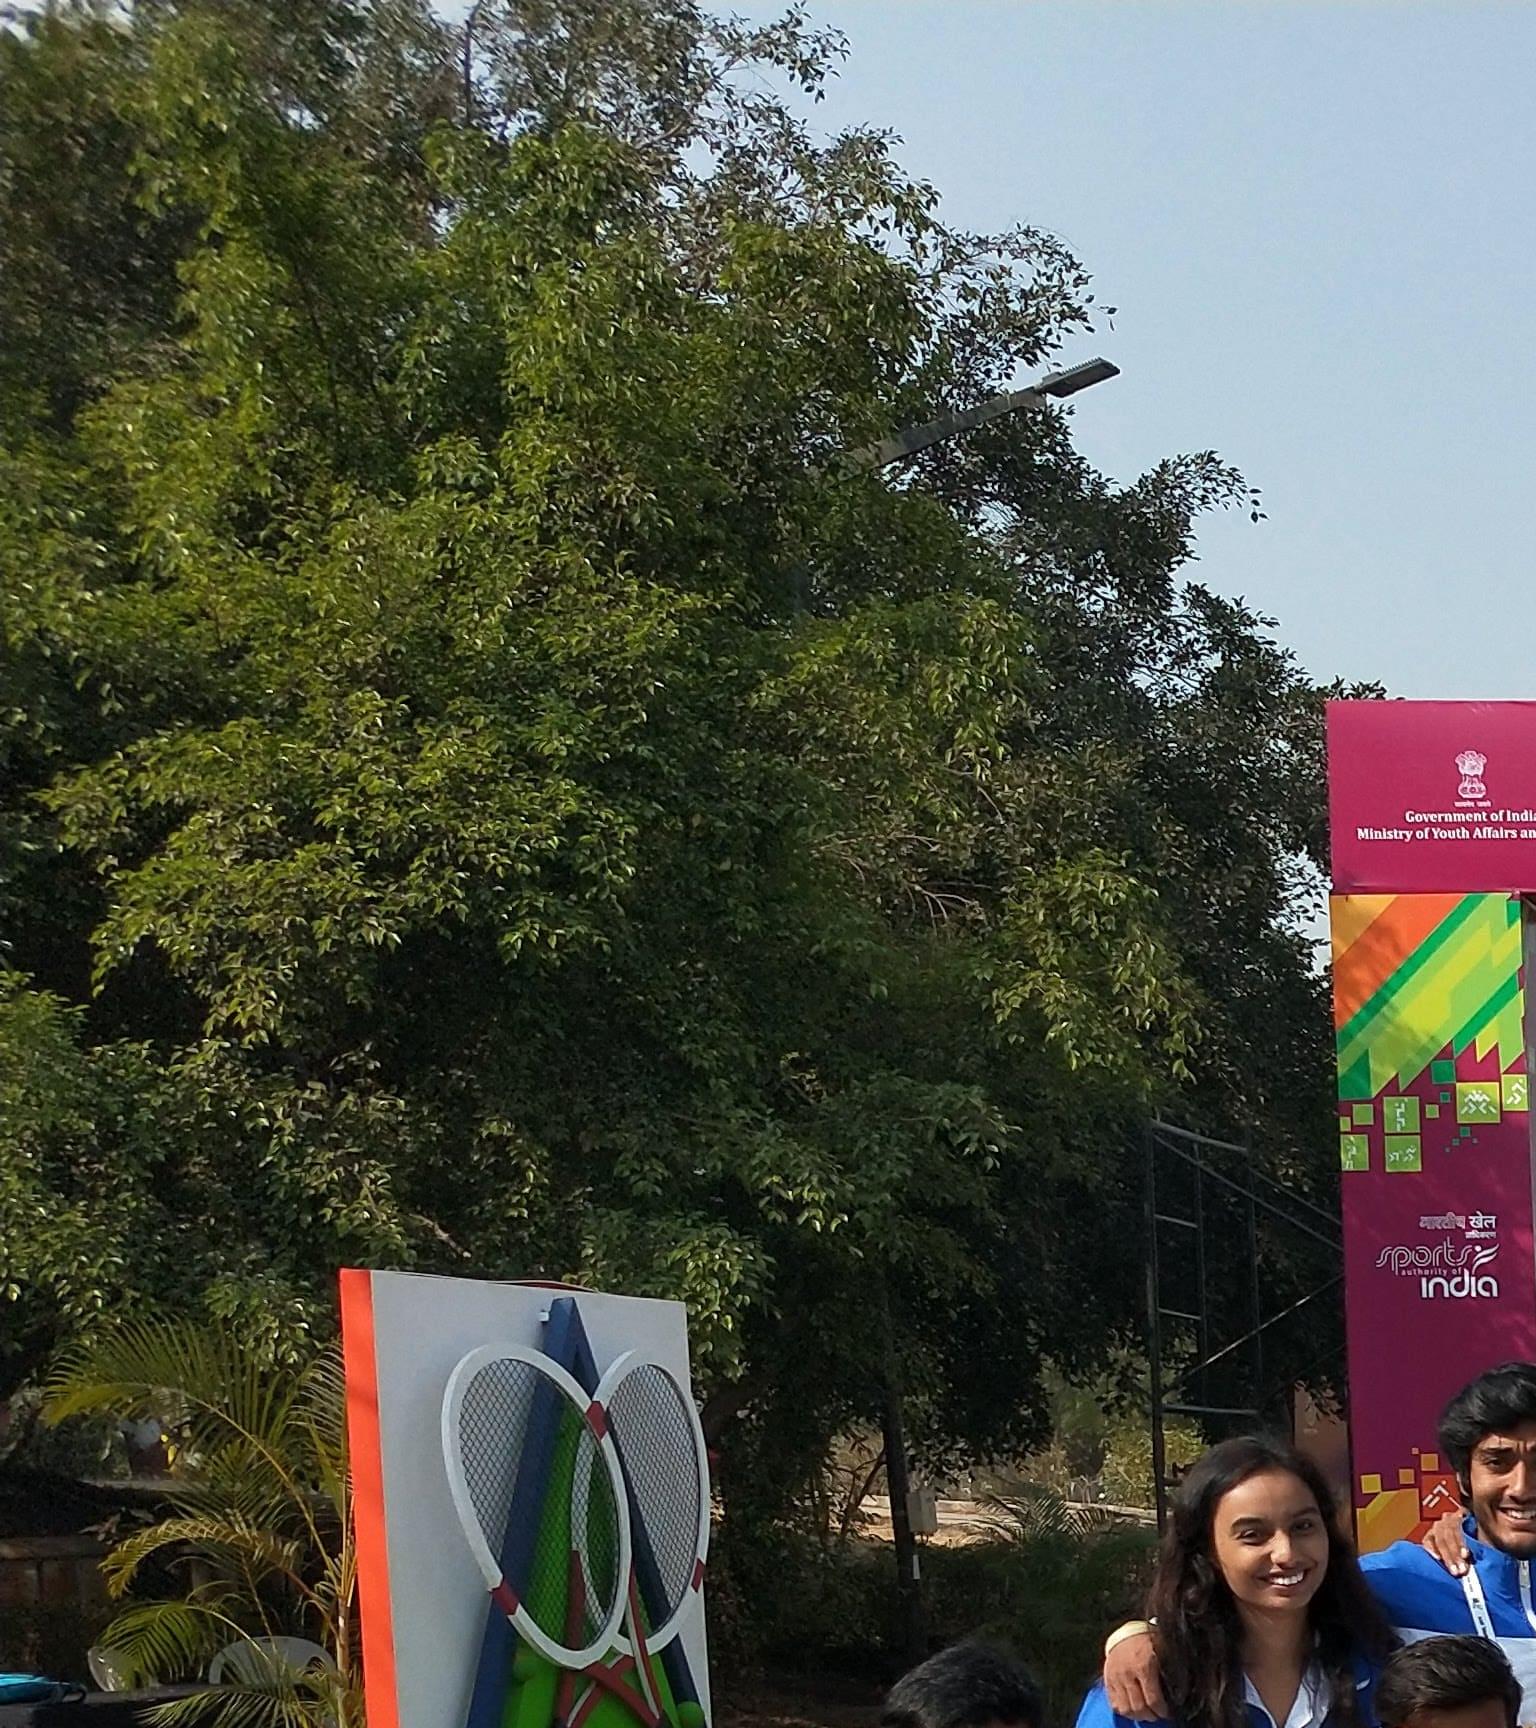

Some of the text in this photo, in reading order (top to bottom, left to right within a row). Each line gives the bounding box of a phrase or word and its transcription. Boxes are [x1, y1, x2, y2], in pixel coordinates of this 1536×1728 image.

[1405, 810, 1488, 823] Government
[1490, 810, 1504, 823] of
[1357, 827, 1413, 842] Ministry
[1416, 827, 1430, 840] of
[1431, 827, 1470, 840] Youth
[1473, 827, 1517, 839] Affairs
[1468, 1211, 1497, 1229] खेल
[1376, 1236, 1472, 1276] sports
[1401, 1267, 1462, 1277] authority of
[1421, 1268, 1498, 1298] india
